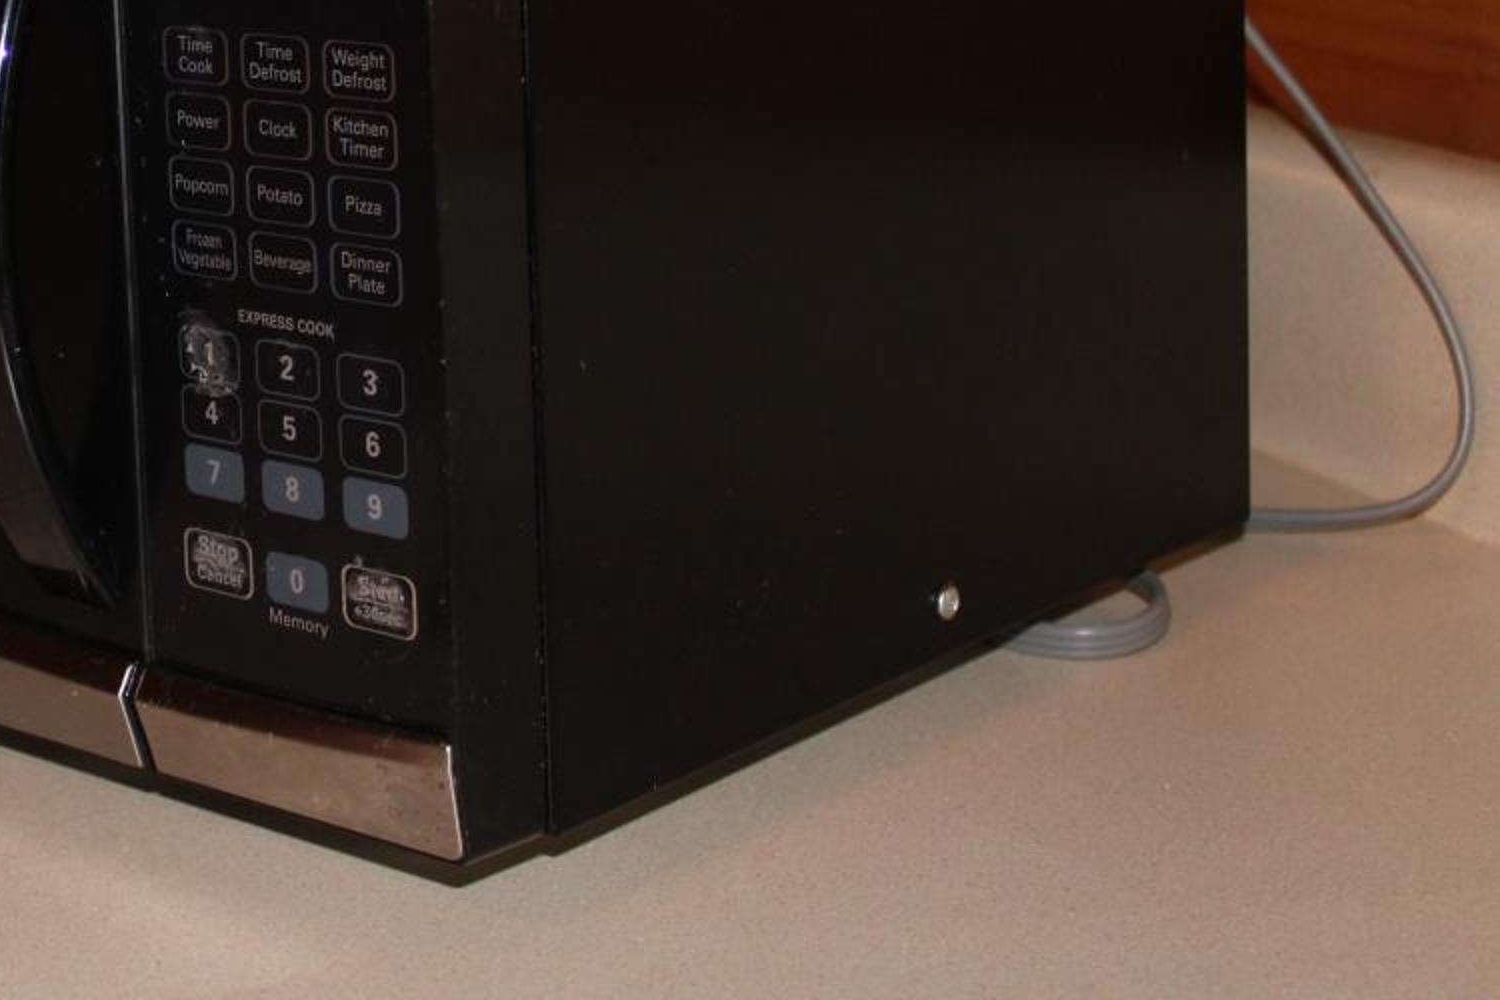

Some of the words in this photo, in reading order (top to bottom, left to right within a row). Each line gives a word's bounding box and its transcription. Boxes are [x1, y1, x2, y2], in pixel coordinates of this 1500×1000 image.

[177, 35, 213, 53] Time
[256, 41, 293, 61] Time
[179, 55, 213, 75] Cook
[332, 49, 385, 71] Weight
[249, 62, 302, 83] Defrost
[332, 69, 387, 91] Defrost
[177, 110, 219, 130] Power
[259, 119, 297, 139] Clock
[333, 116, 389, 138] Kitchen
[340, 138, 384, 159] Timer
[175, 174, 229, 196] Popcorn
[257, 184, 303, 206] Potato
[345, 195, 382, 216] Pizza
[185, 228, 222, 247] Frozen
[178, 249, 231, 272] Vegetable
[254, 250, 312, 275] Beverage
[341, 252, 390, 273] Dinner
[348, 273, 385, 295] Plate
[238, 308, 294, 332] EXPRESS
[297, 318, 335, 340] COOK
[279, 354, 295, 381] 2
[363, 369, 379, 396] 3
[205, 400, 219, 425] 4
[283, 416, 297, 442] 5
[365, 431, 381, 458] 6
[207, 459, 221, 485] 7
[285, 476, 299, 503] 8
[368, 494, 382, 520] 9
[198, 535, 239, 563] Stop
[291, 569, 303, 594] 0
[269, 607, 329, 638] Memory
